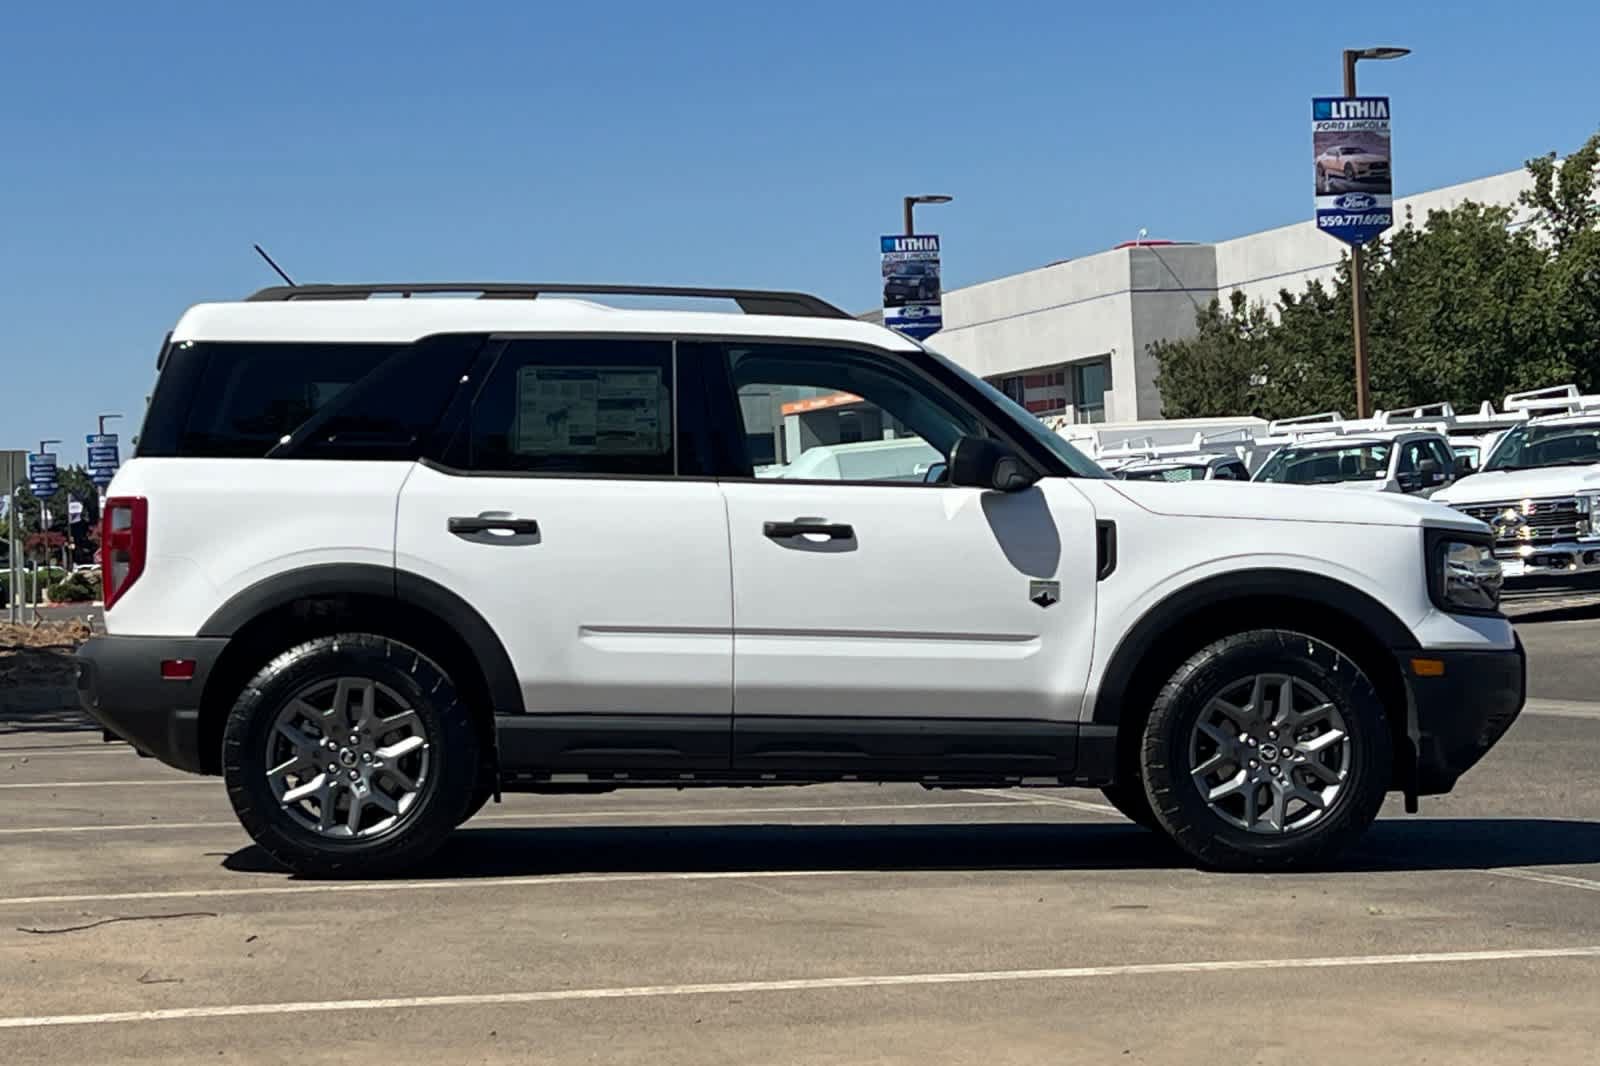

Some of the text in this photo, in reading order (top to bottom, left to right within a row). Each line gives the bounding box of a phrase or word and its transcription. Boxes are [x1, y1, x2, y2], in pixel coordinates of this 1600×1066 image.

[1331, 101, 1388, 118] LITHIA
[1316, 120, 1388, 130] FORD LINCOLN
[895, 238, 937, 251] LITHIA
